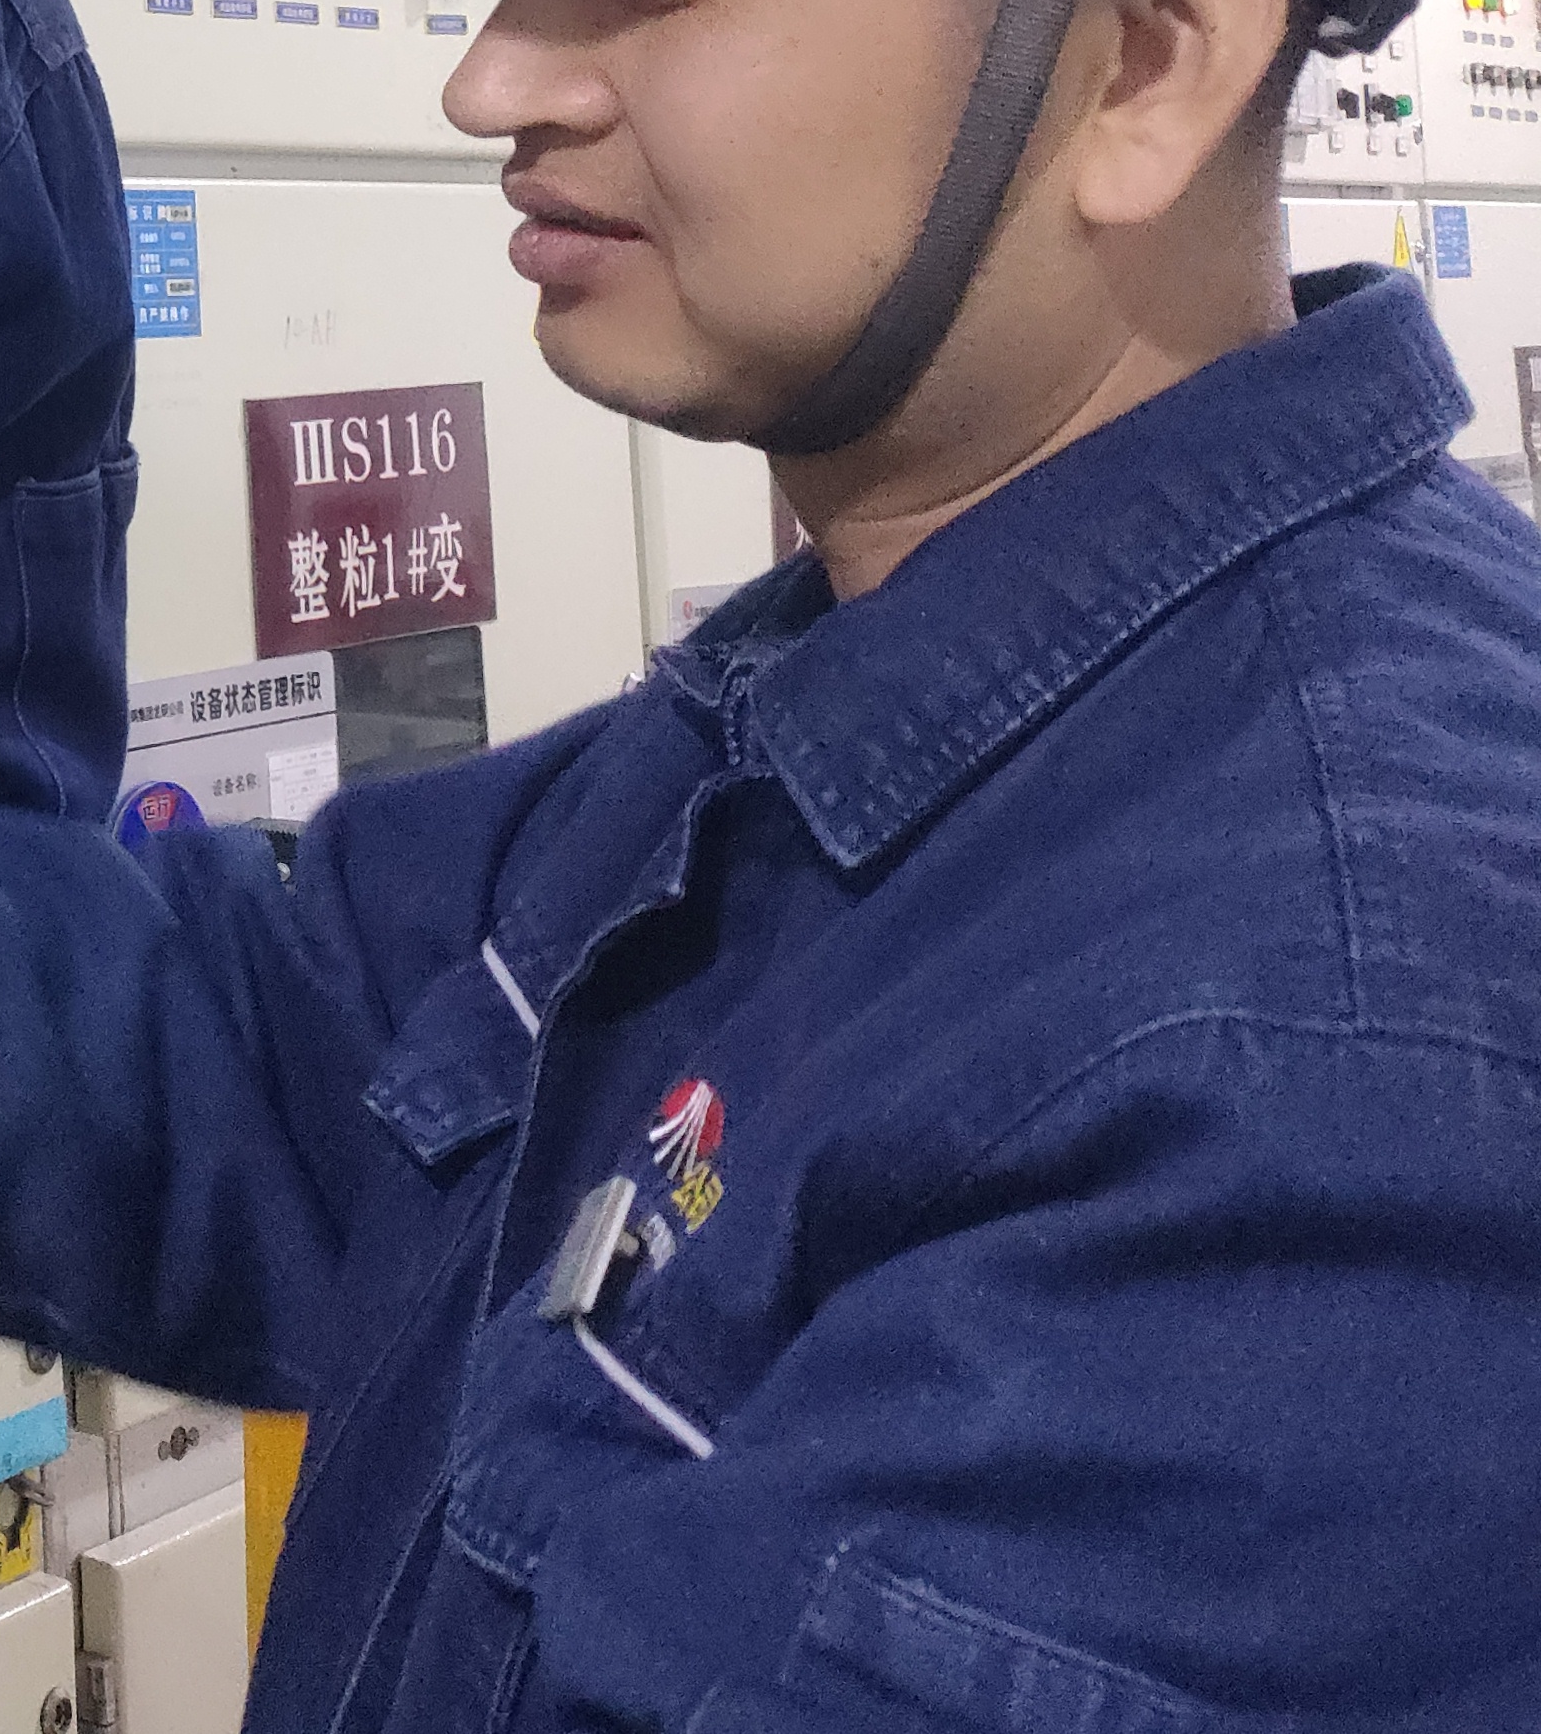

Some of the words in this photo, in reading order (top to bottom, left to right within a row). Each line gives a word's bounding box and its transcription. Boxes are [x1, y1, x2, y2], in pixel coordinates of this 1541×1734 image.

[288, 513, 466, 624] 整粒1#变
[190, 671, 322, 724] 设备状态管理标识
